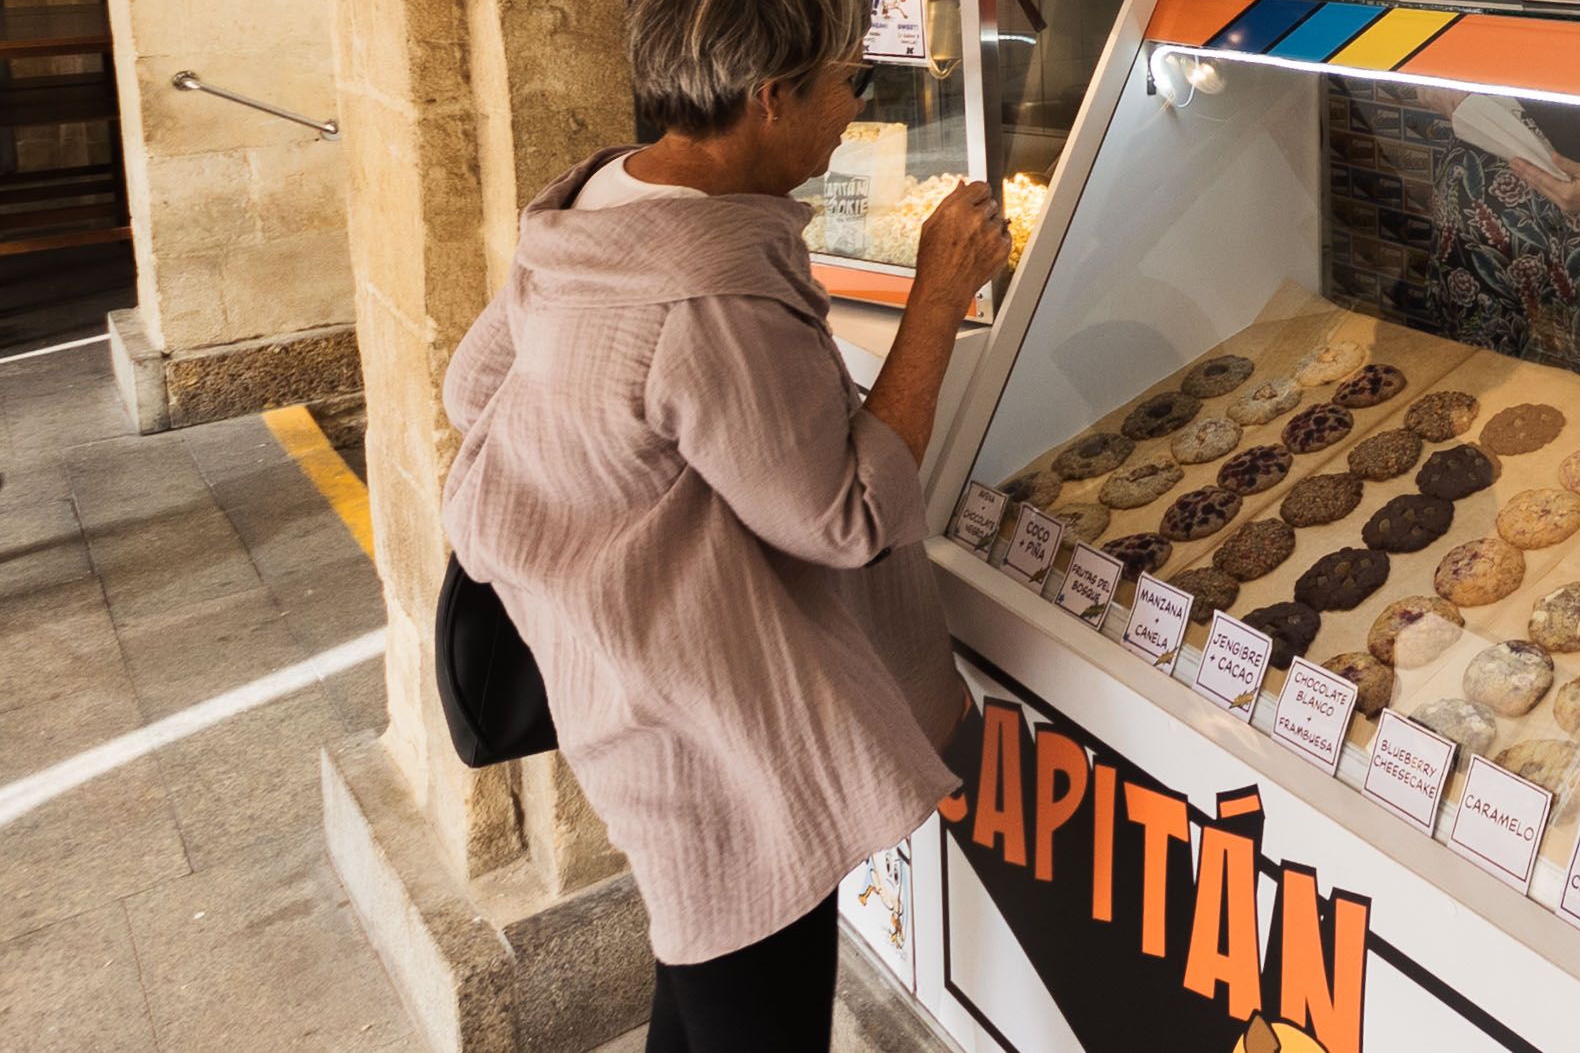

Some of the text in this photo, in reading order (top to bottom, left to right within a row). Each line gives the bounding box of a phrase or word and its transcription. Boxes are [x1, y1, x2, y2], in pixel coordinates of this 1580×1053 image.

[1026, 521, 1050, 543] COCO
[1025, 541, 1045, 562] PIÑA
[1140, 589, 1183, 619] MANZANA
[1135, 624, 1168, 650] CANELA
[1213, 633, 1263, 668] JENGIBRE
[1218, 657, 1254, 685] CACAO
[1293, 671, 1348, 706] CHOCOLATE
[1295, 690, 1335, 718] BLANCO
[1278, 717, 1334, 754] FRAMBUESA
[1380, 739, 1438, 778] BLUEBERRY
[1372, 754, 1437, 800] CHEESECAKE
[1464, 794, 1535, 843] CARAMELO
